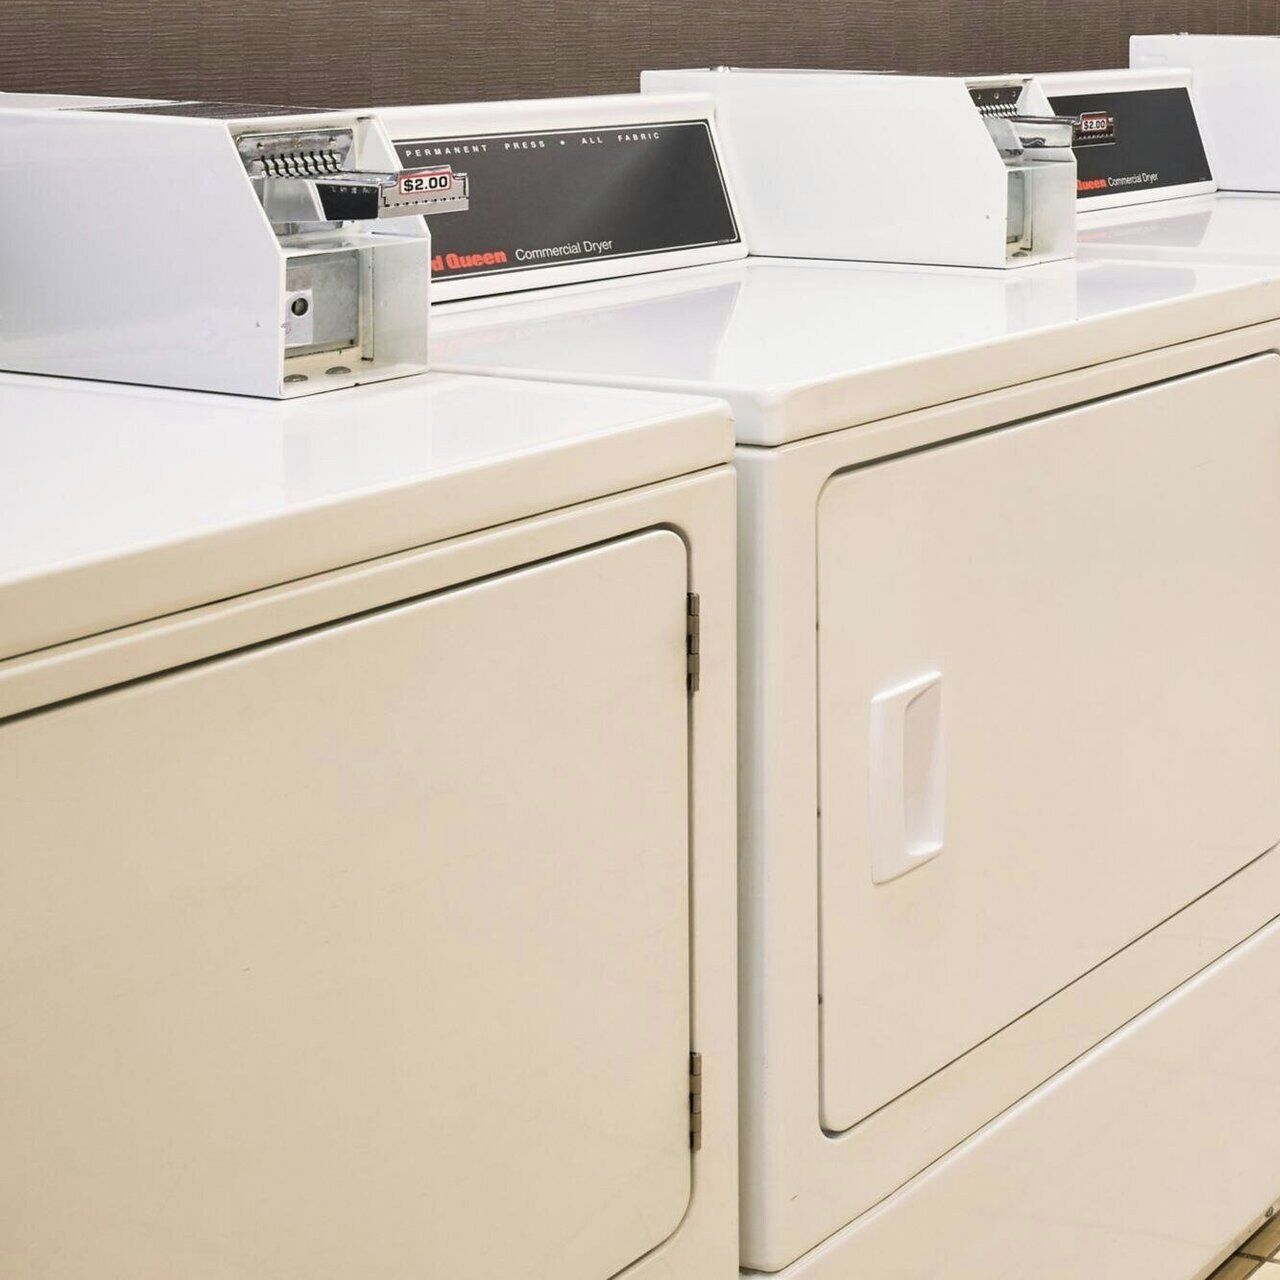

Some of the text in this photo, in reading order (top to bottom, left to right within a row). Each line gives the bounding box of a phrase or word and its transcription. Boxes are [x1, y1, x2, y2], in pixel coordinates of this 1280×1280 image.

[1083, 119, 1106, 130] $2.00
[405, 132, 660, 158] PERMANENT PRESS ALL FABRIC
[403, 175, 448, 192] $2.00
[1107, 174, 1142, 186] Commercial
[1141, 172, 1159, 184] Dryer
[446, 250, 507, 270] Queen
[515, 242, 581, 261] Commercial
[583, 238, 613, 254] Dryer
